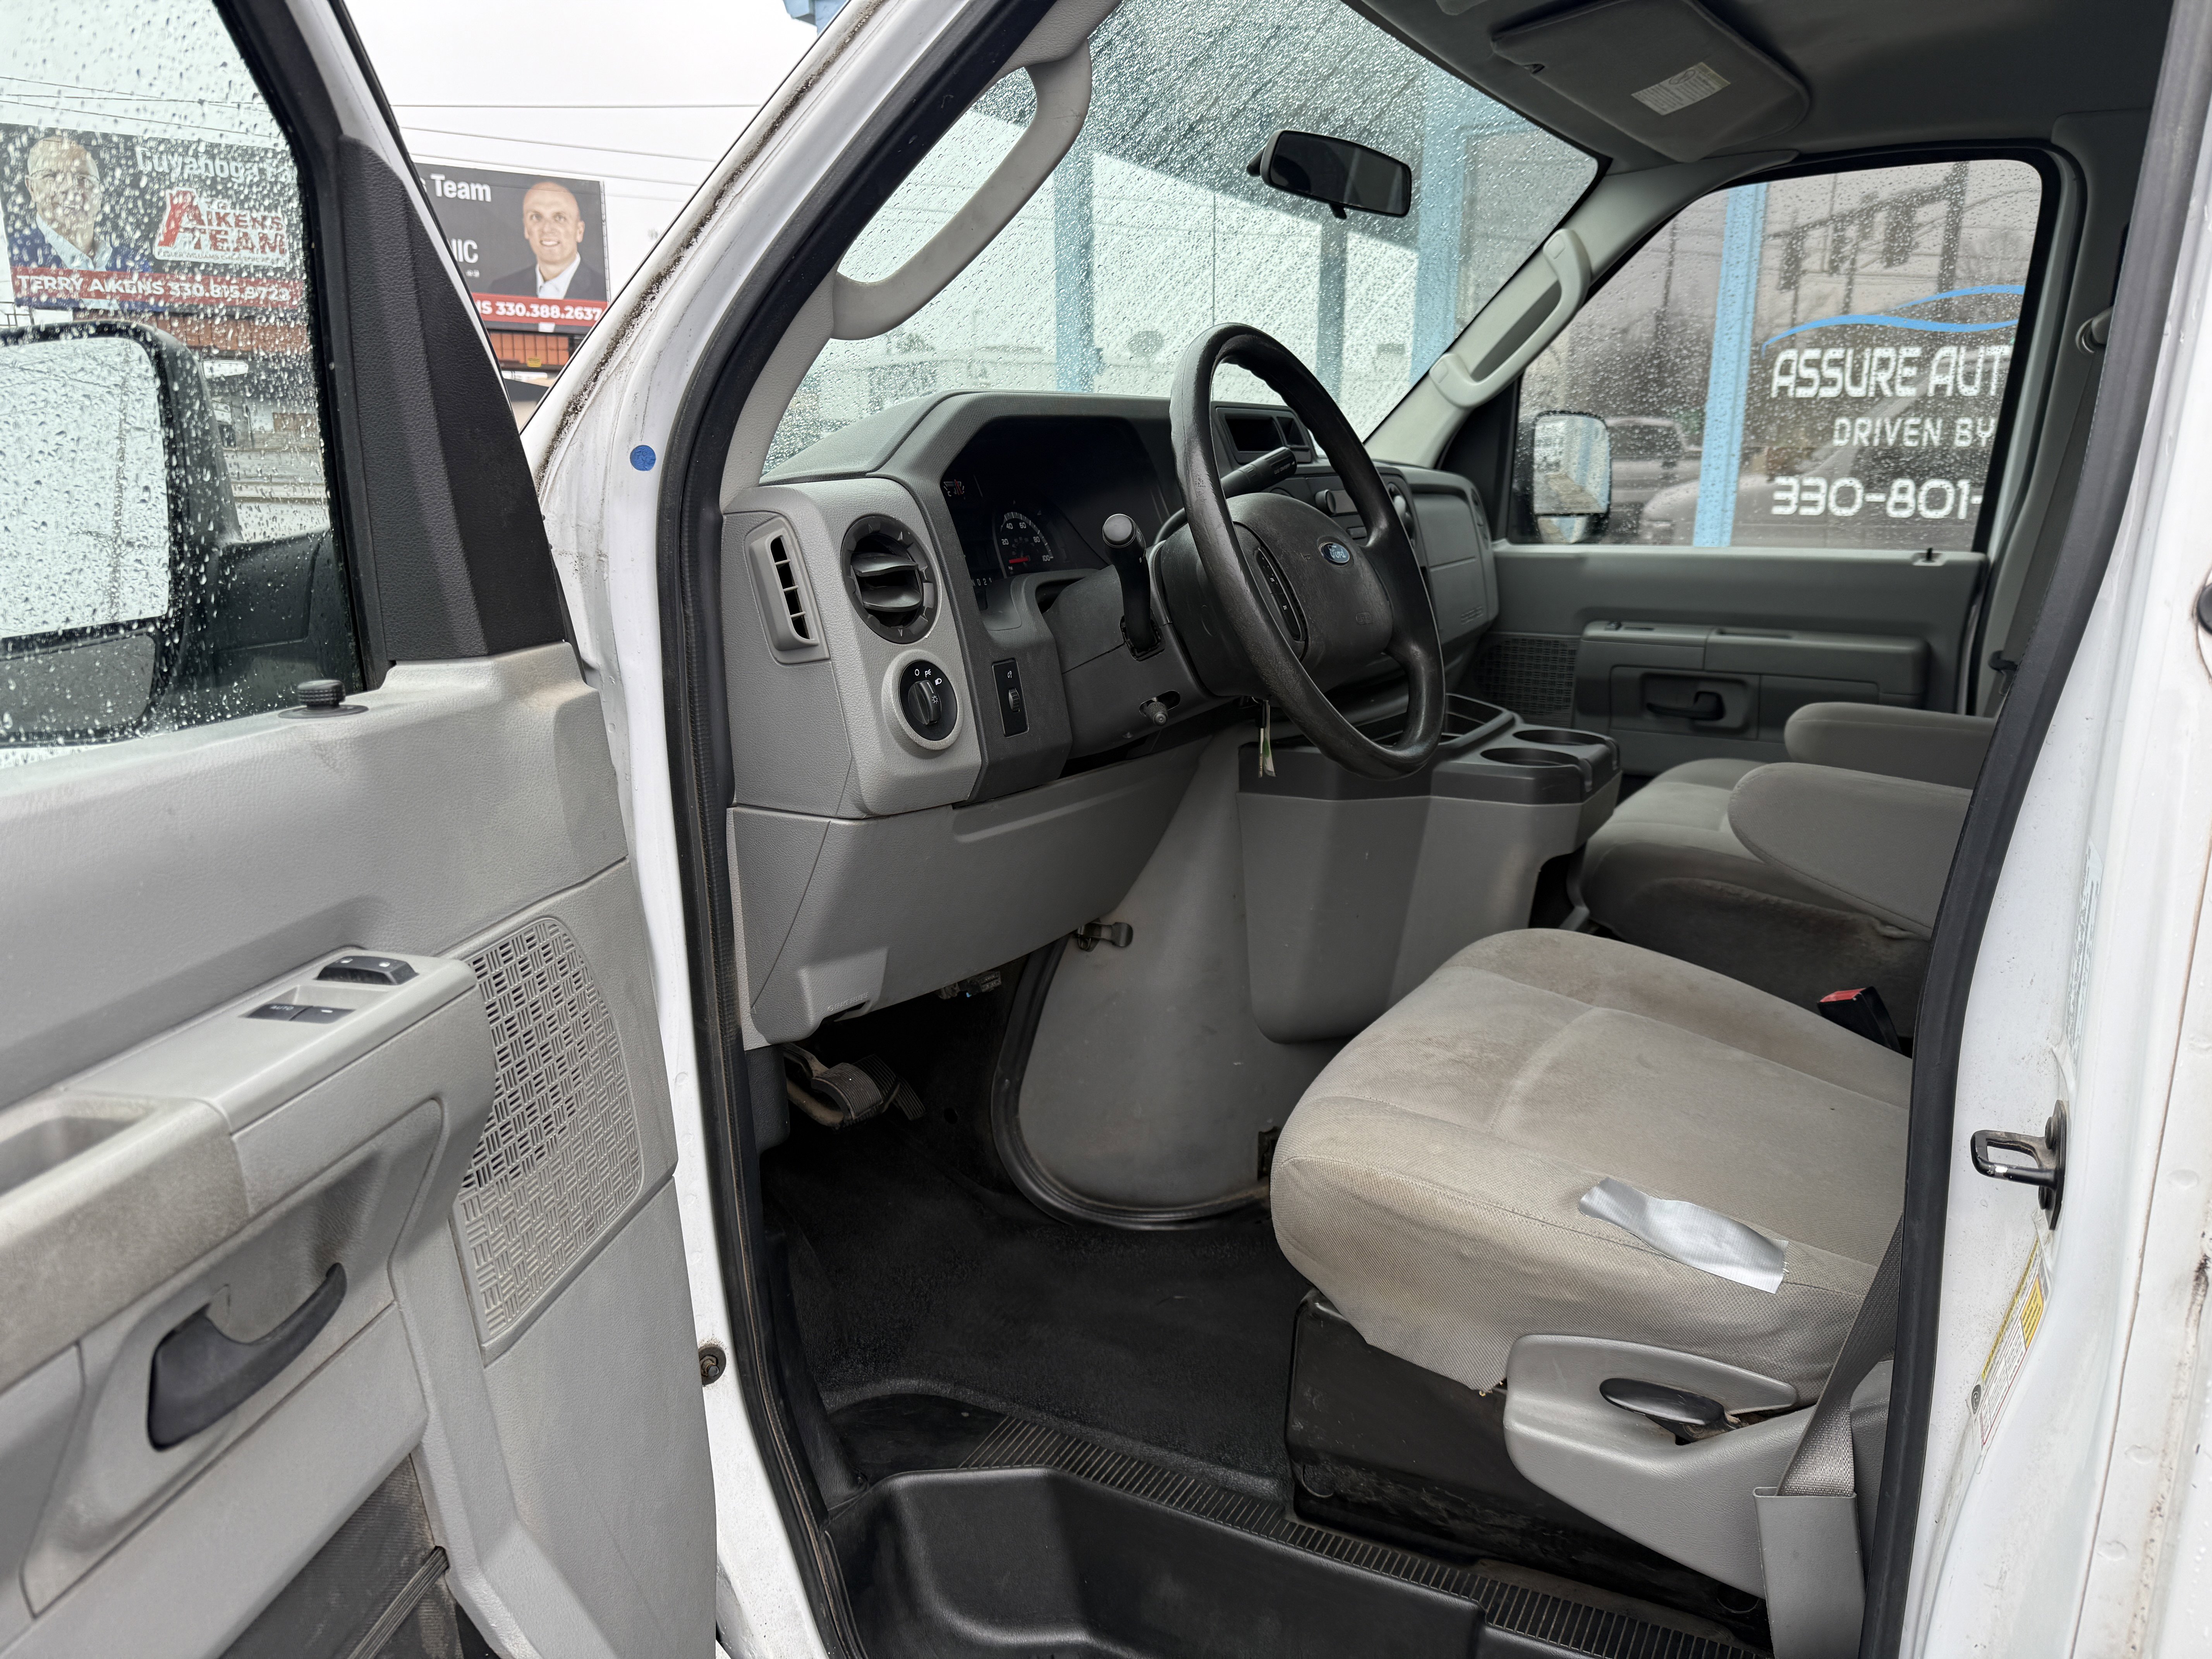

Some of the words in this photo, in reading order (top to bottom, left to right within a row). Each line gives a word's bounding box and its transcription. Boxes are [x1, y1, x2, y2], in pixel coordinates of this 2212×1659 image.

[430, 173, 491, 202] Team
[17, 275, 84, 292] TERRY
[89, 278, 165, 295] AIKENS
[496, 302, 603, 321] 330.388.2637
[1771, 346, 1922, 398] ASSURE
[1927, 345, 2013, 397] AUT
[1833, 417, 1942, 447] DRIVEN
[1955, 418, 1996, 447] BY
[1327, 544, 1346, 558] Ford
